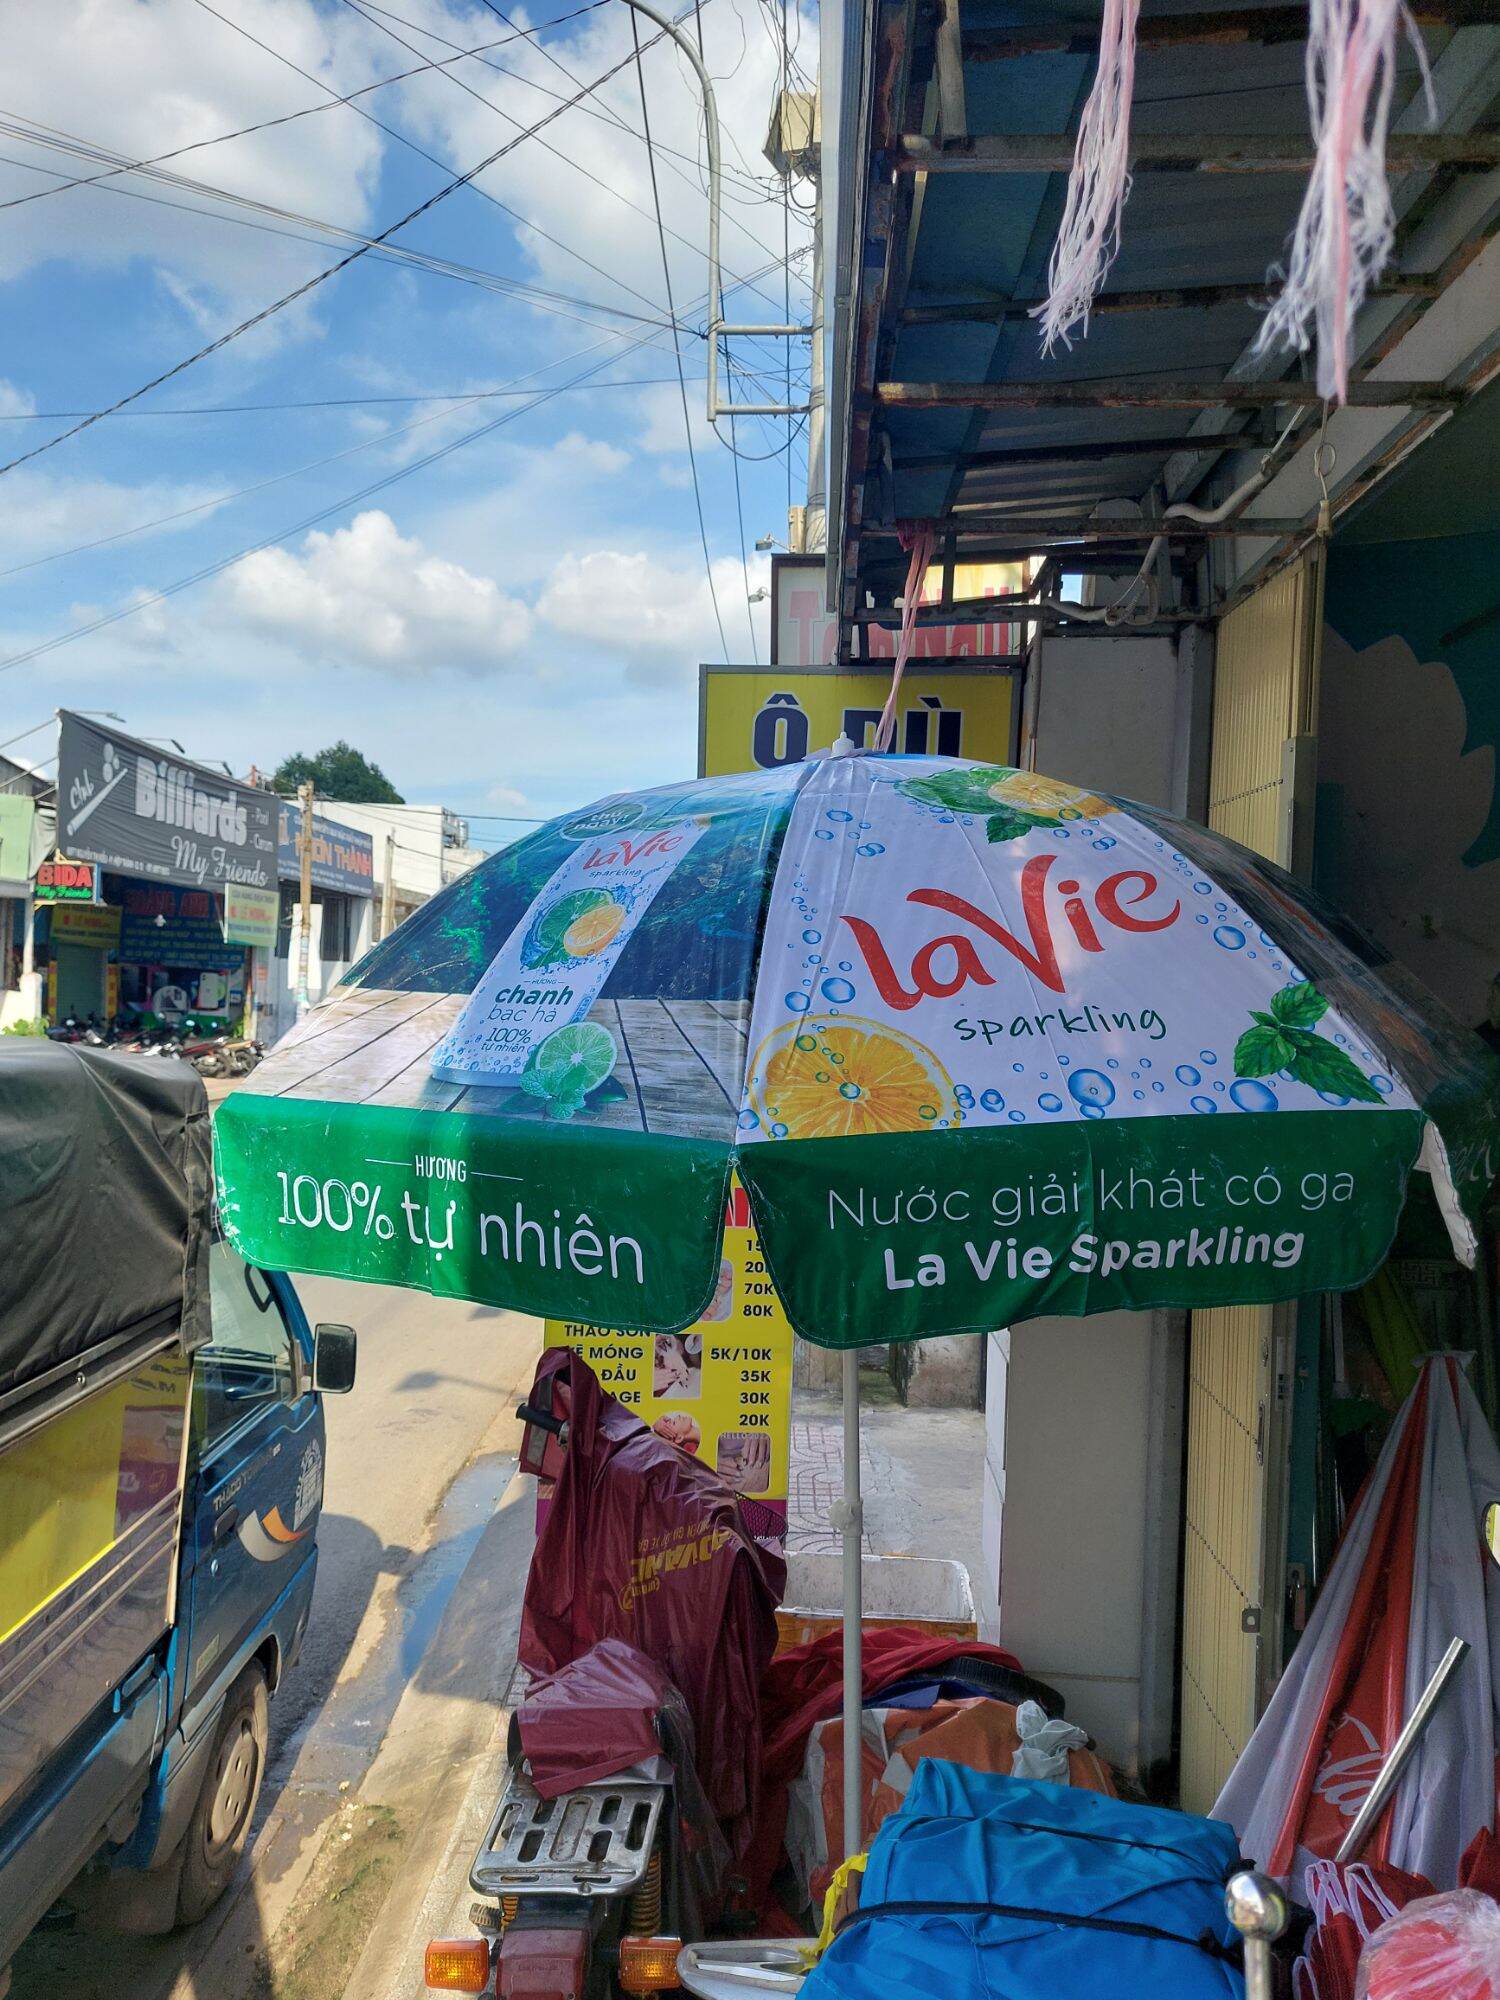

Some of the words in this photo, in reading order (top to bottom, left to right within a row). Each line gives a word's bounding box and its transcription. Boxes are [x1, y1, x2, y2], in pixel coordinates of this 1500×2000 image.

[753, 693, 809, 769] Ô
[135, 756, 248, 846] Billiards
[170, 835, 209, 885] My
[211, 847, 269, 887] Friends
[38, 864, 93, 887] BIDA
[495, 984, 574, 1006] chanh
[487, 1004, 527, 1024] bạc
[485, 1027, 533, 1044] 100%
[954, 1005, 1167, 1046] sparkling
[415, 1154, 467, 1182] HƯƠNG
[829, 1185, 970, 1230] Nước
[991, 1172, 1080, 1226] giải
[1100, 1167, 1206, 1213] khát
[1225, 1167, 1283, 1206] có
[1300, 1172, 1355, 1210] ga
[277, 1172, 395, 1240] 100%
[401, 1190, 456, 1261] tự
[480, 1202, 644, 1284] nhiên
[744, 1261, 769, 1274] 20
[884, 1248, 945, 1290] La
[965, 1237, 1053, 1282] Vie
[1069, 1225, 1305, 1278] Sparkling
[744, 1283, 774, 1296] 70K
[743, 1304, 774, 1317] 80K
[589, 1343, 644, 1359] MÓNG
[711, 1348, 772, 1361] 5K/10K
[601, 1363, 637, 1381] ĐẦU
[740, 1370, 772, 1382] 35K
[740, 1392, 770, 1404] 30K
[739, 1414, 770, 1426] 20K
